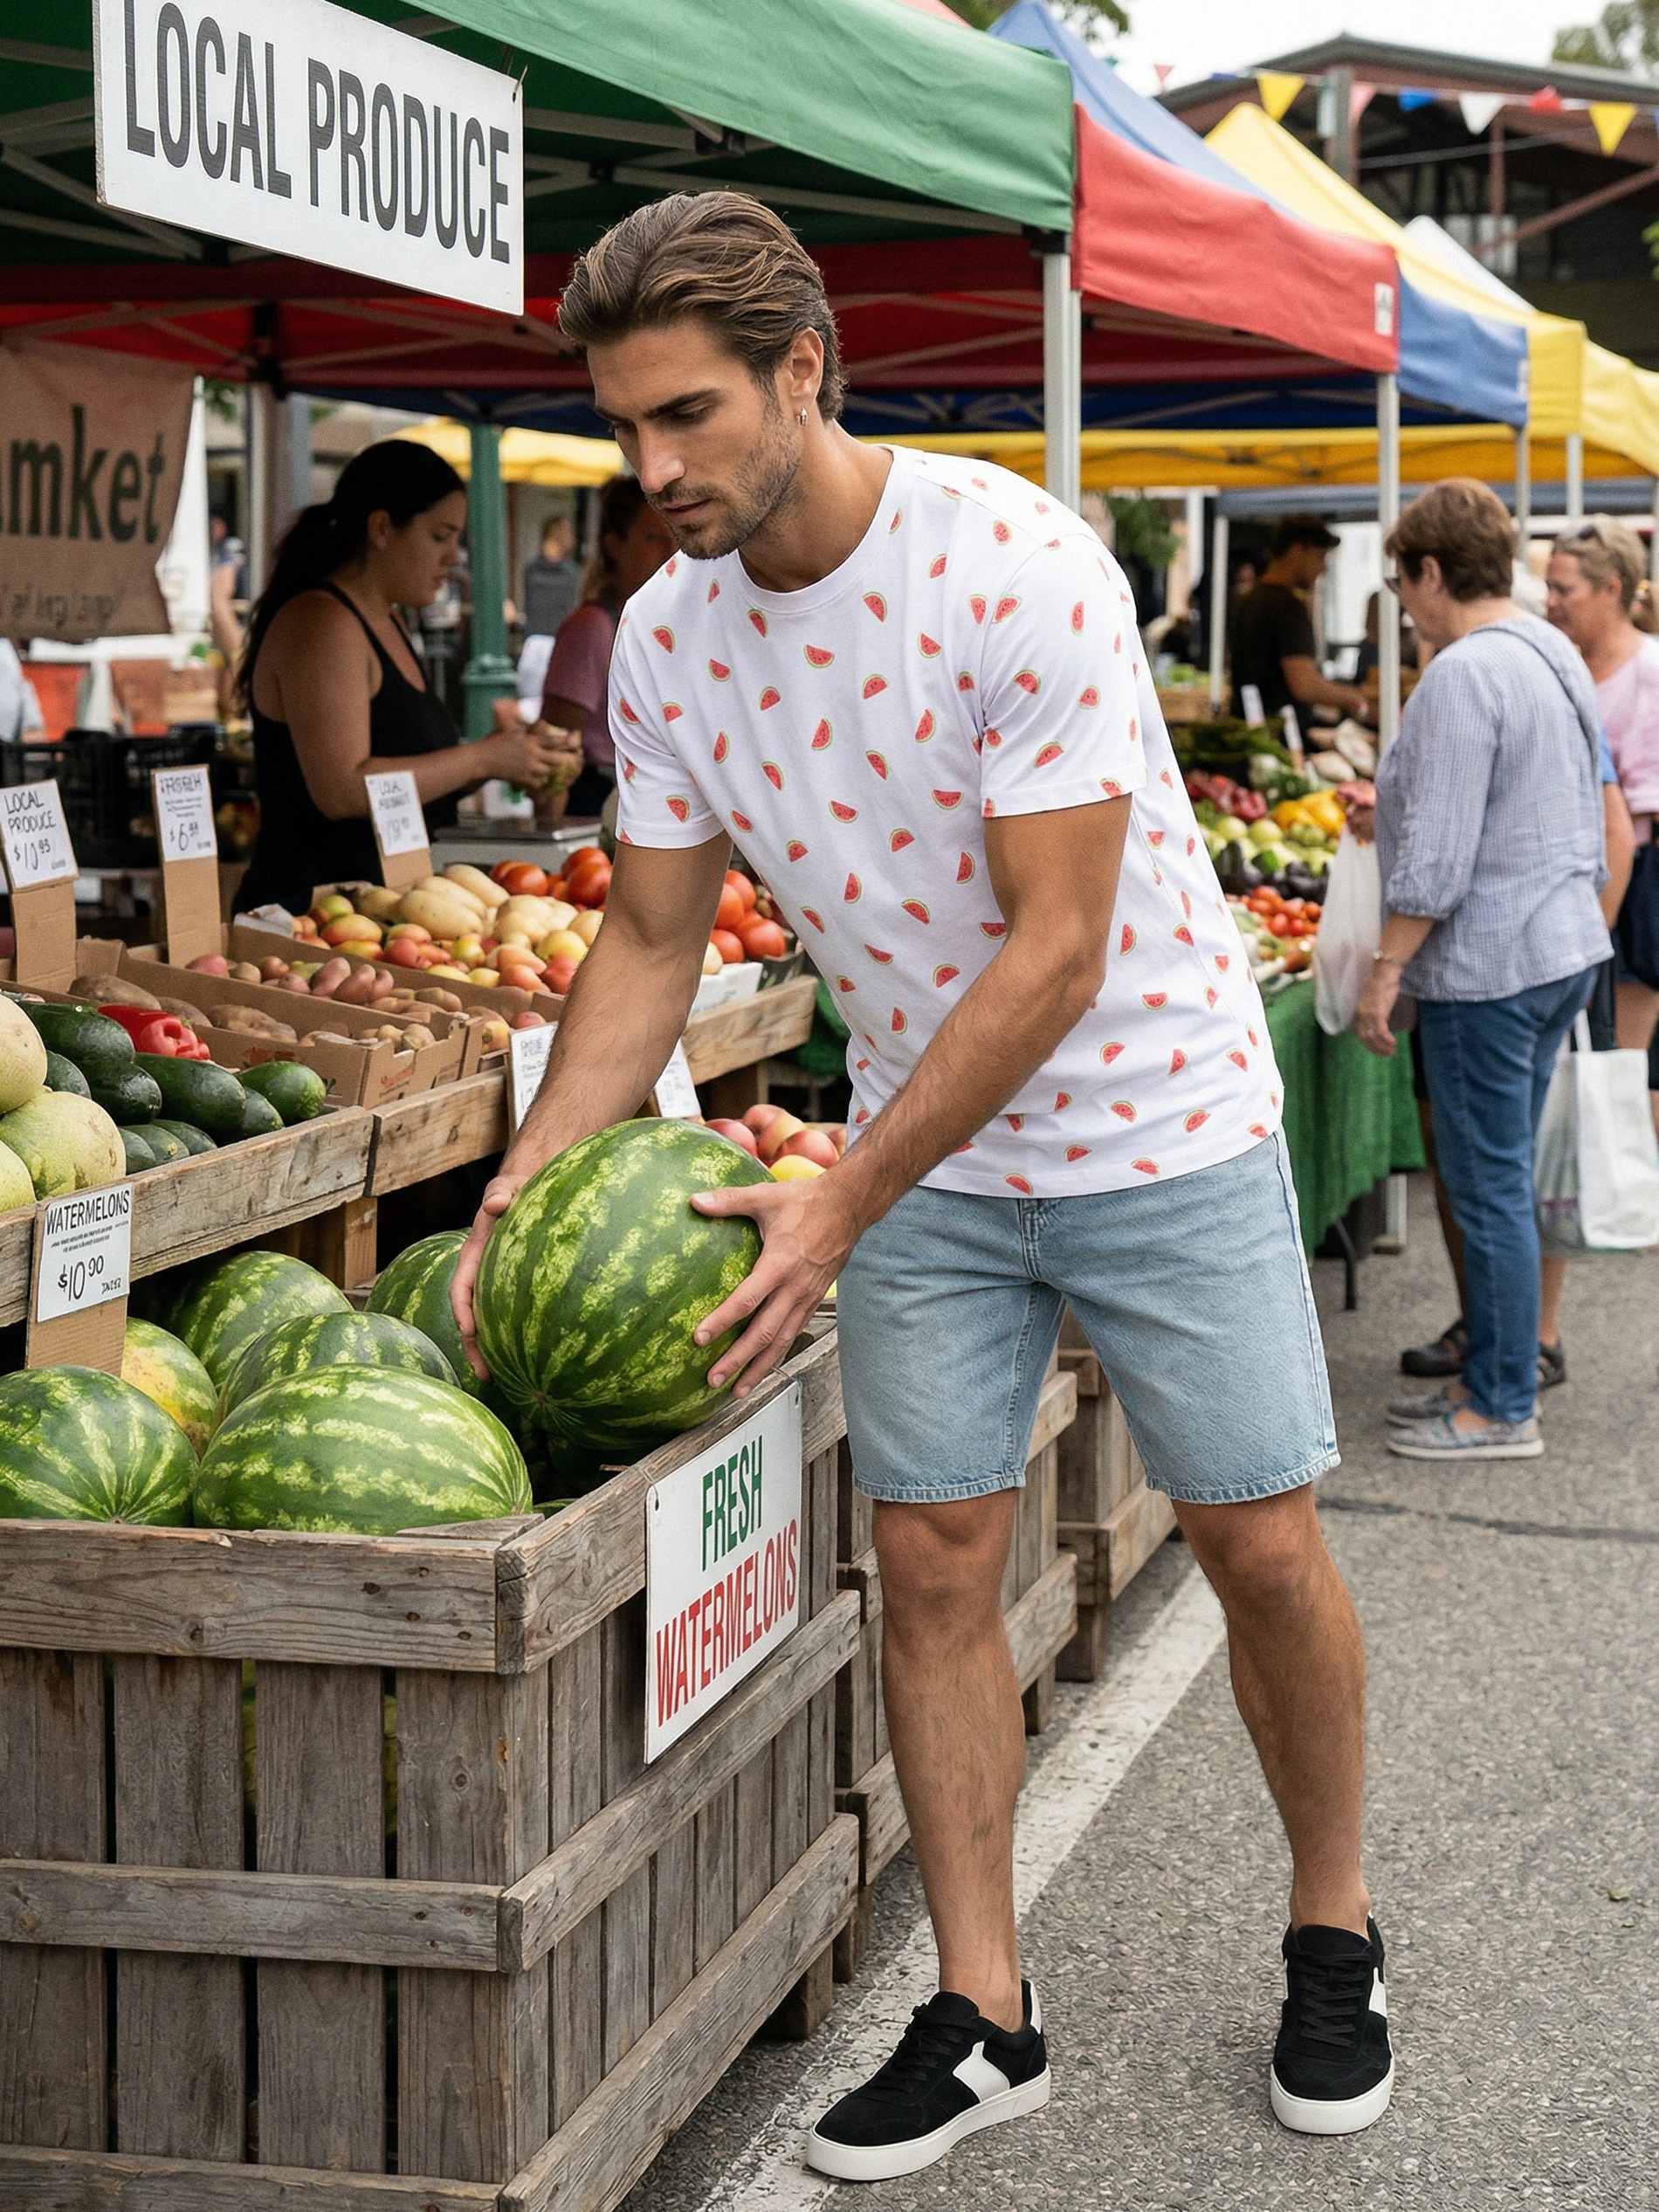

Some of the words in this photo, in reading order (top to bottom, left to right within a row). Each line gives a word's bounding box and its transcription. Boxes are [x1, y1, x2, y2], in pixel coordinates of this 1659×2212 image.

[124, 0, 292, 199] LOCAL
[308, 58, 510, 264] PRODUCE
[0, 403, 165, 546] mket
[4, 789, 45, 815] LOCAL
[8, 810, 56, 836] PRODUCE
[46, 1189, 130, 1236] WATERMELONS
[702, 1435, 763, 1572] FRESH
[656, 1518, 797, 1728] WATERMELONS
